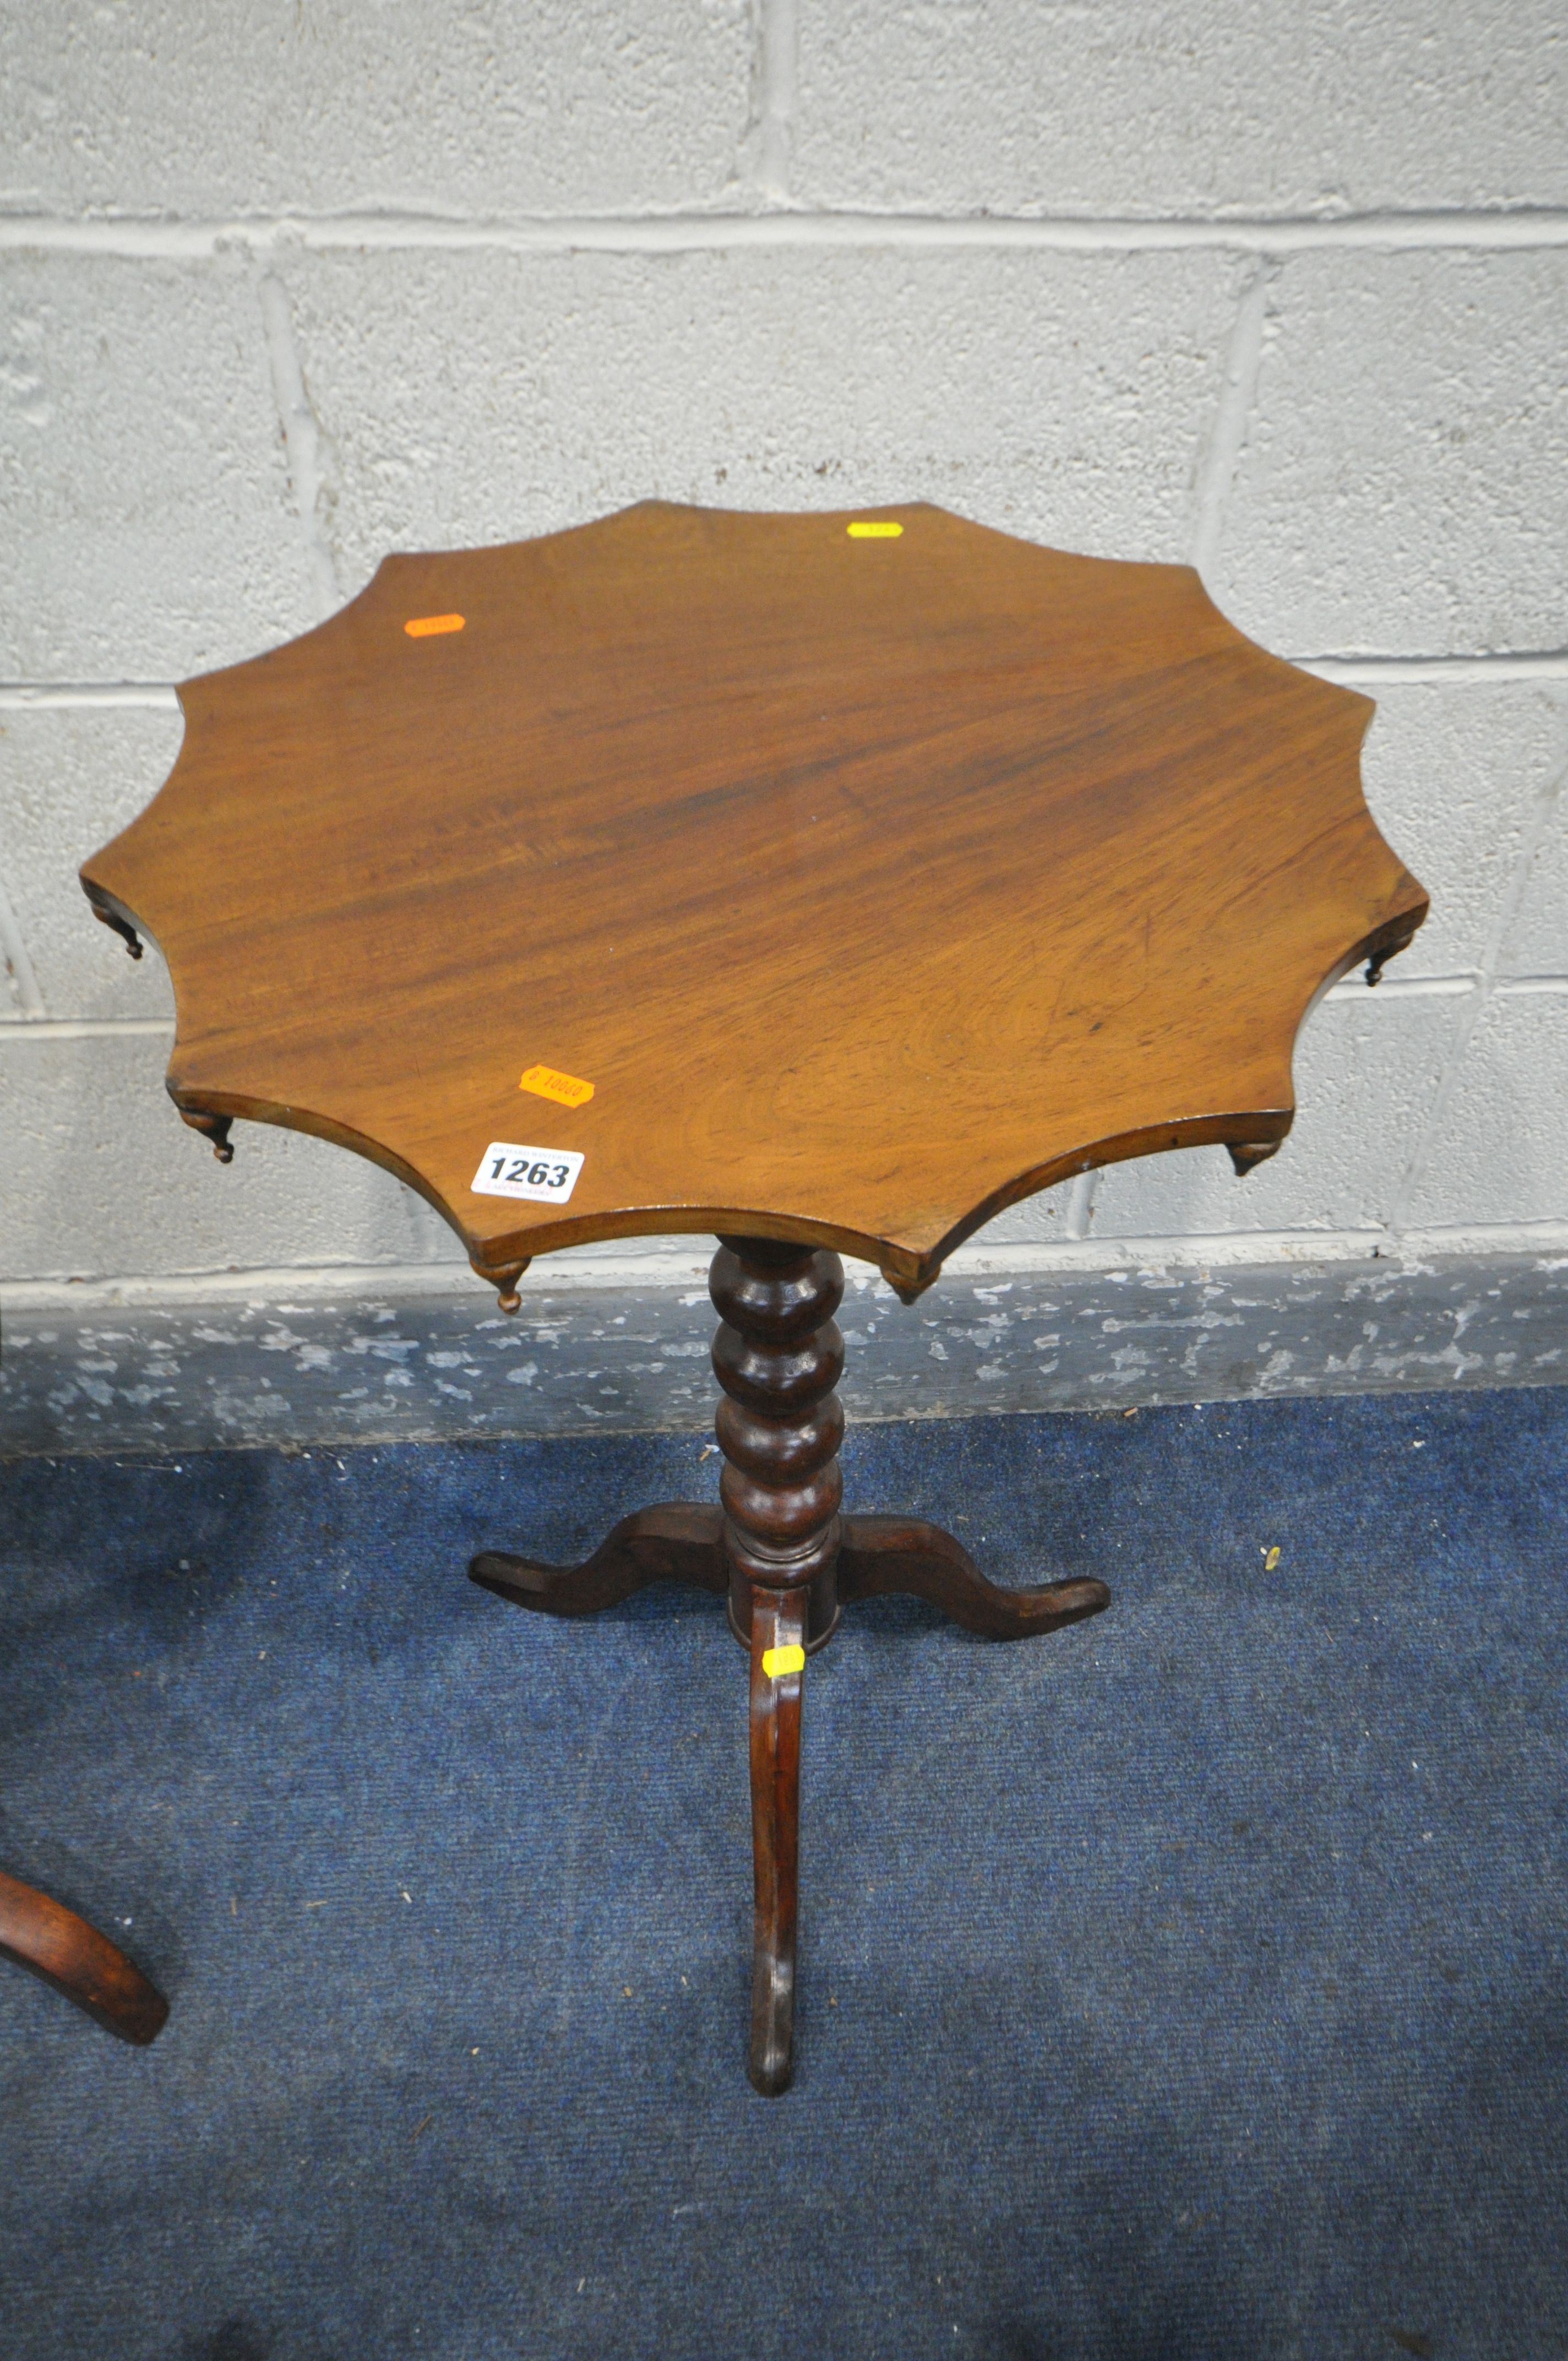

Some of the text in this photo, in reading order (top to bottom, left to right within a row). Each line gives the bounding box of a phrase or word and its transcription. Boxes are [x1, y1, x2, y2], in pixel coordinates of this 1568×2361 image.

[544, 1075, 582, 1096] 10060
[493, 1146, 579, 1162] RICHARD WINTERTON
[491, 1158, 570, 1188] 1263
